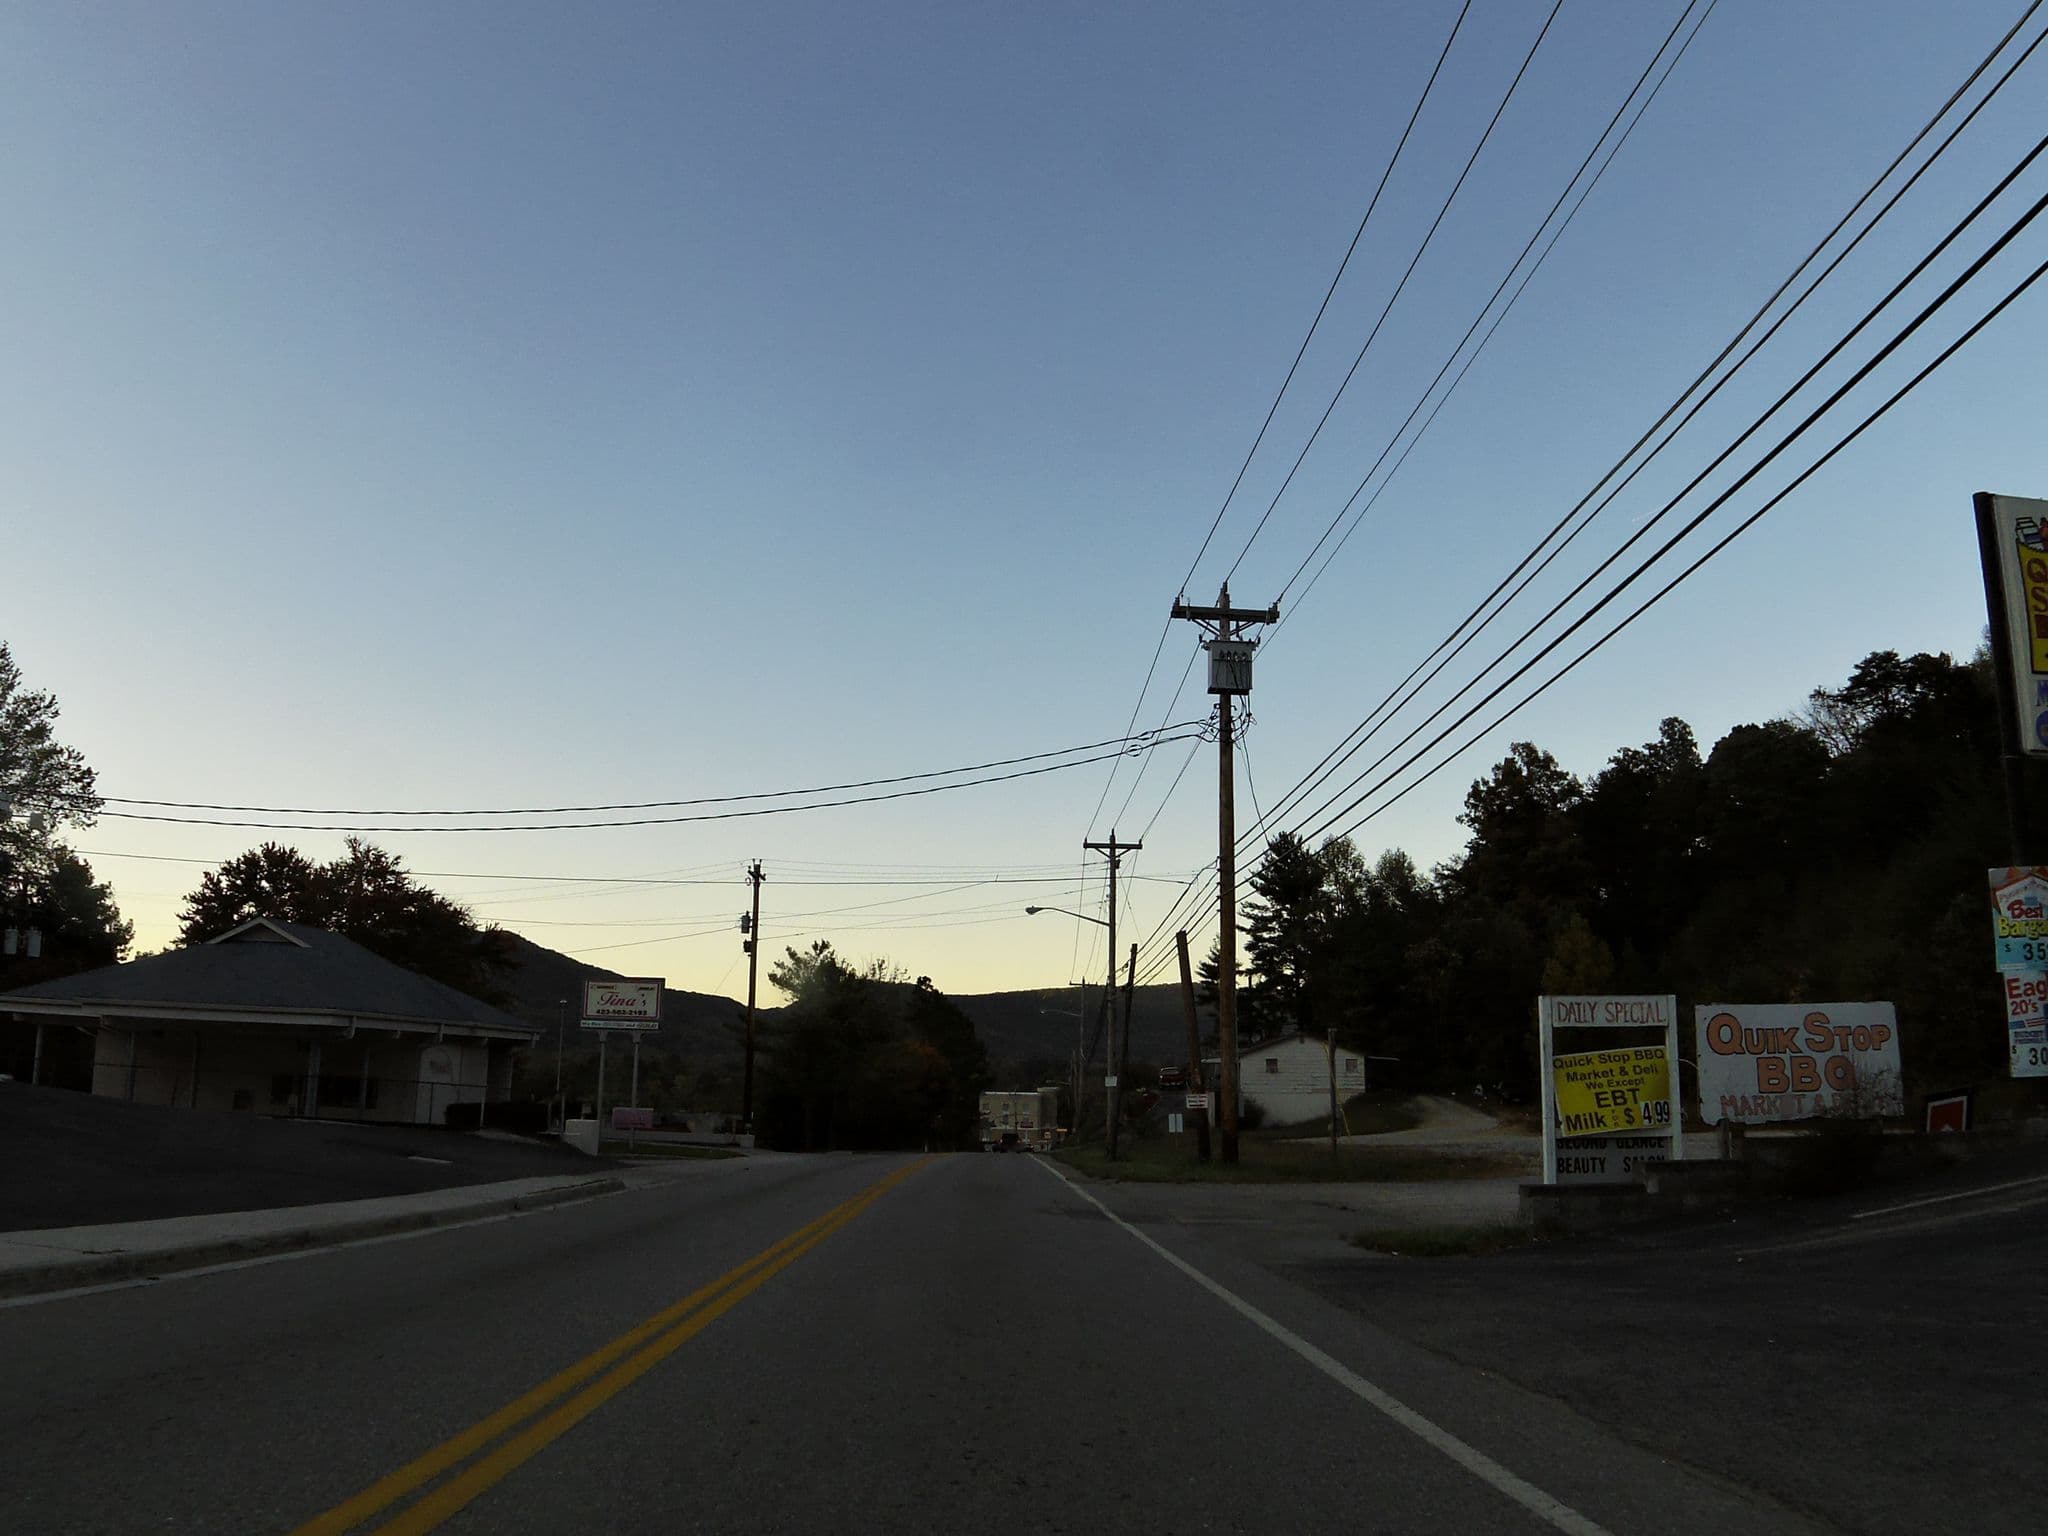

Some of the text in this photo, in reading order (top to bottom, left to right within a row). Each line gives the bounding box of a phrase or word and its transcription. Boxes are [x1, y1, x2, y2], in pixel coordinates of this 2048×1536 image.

[2007, 899, 2043, 919] Best
[2006, 977, 2048, 1001] Eag
[1557, 1001, 1663, 1024] DAILY SPECIAL
[2010, 1000, 2039, 1015] 20's
[1706, 1011, 1892, 1056] QUIK STOP
[1553, 1048, 1665, 1070] Quick Stop BBQ
[1566, 1063, 1658, 1083] Market & Deli
[1585, 1077, 1645, 1090] We Except
[1756, 1054, 1858, 1095] BBQ
[1594, 1088, 1641, 1108] EBT
[1720, 1095, 1805, 1117] MARKT
[1565, 1112, 1608, 1132] Milk
[1623, 1107, 1635, 1125] $
[1557, 1156, 1606, 1174] BEAUTY
